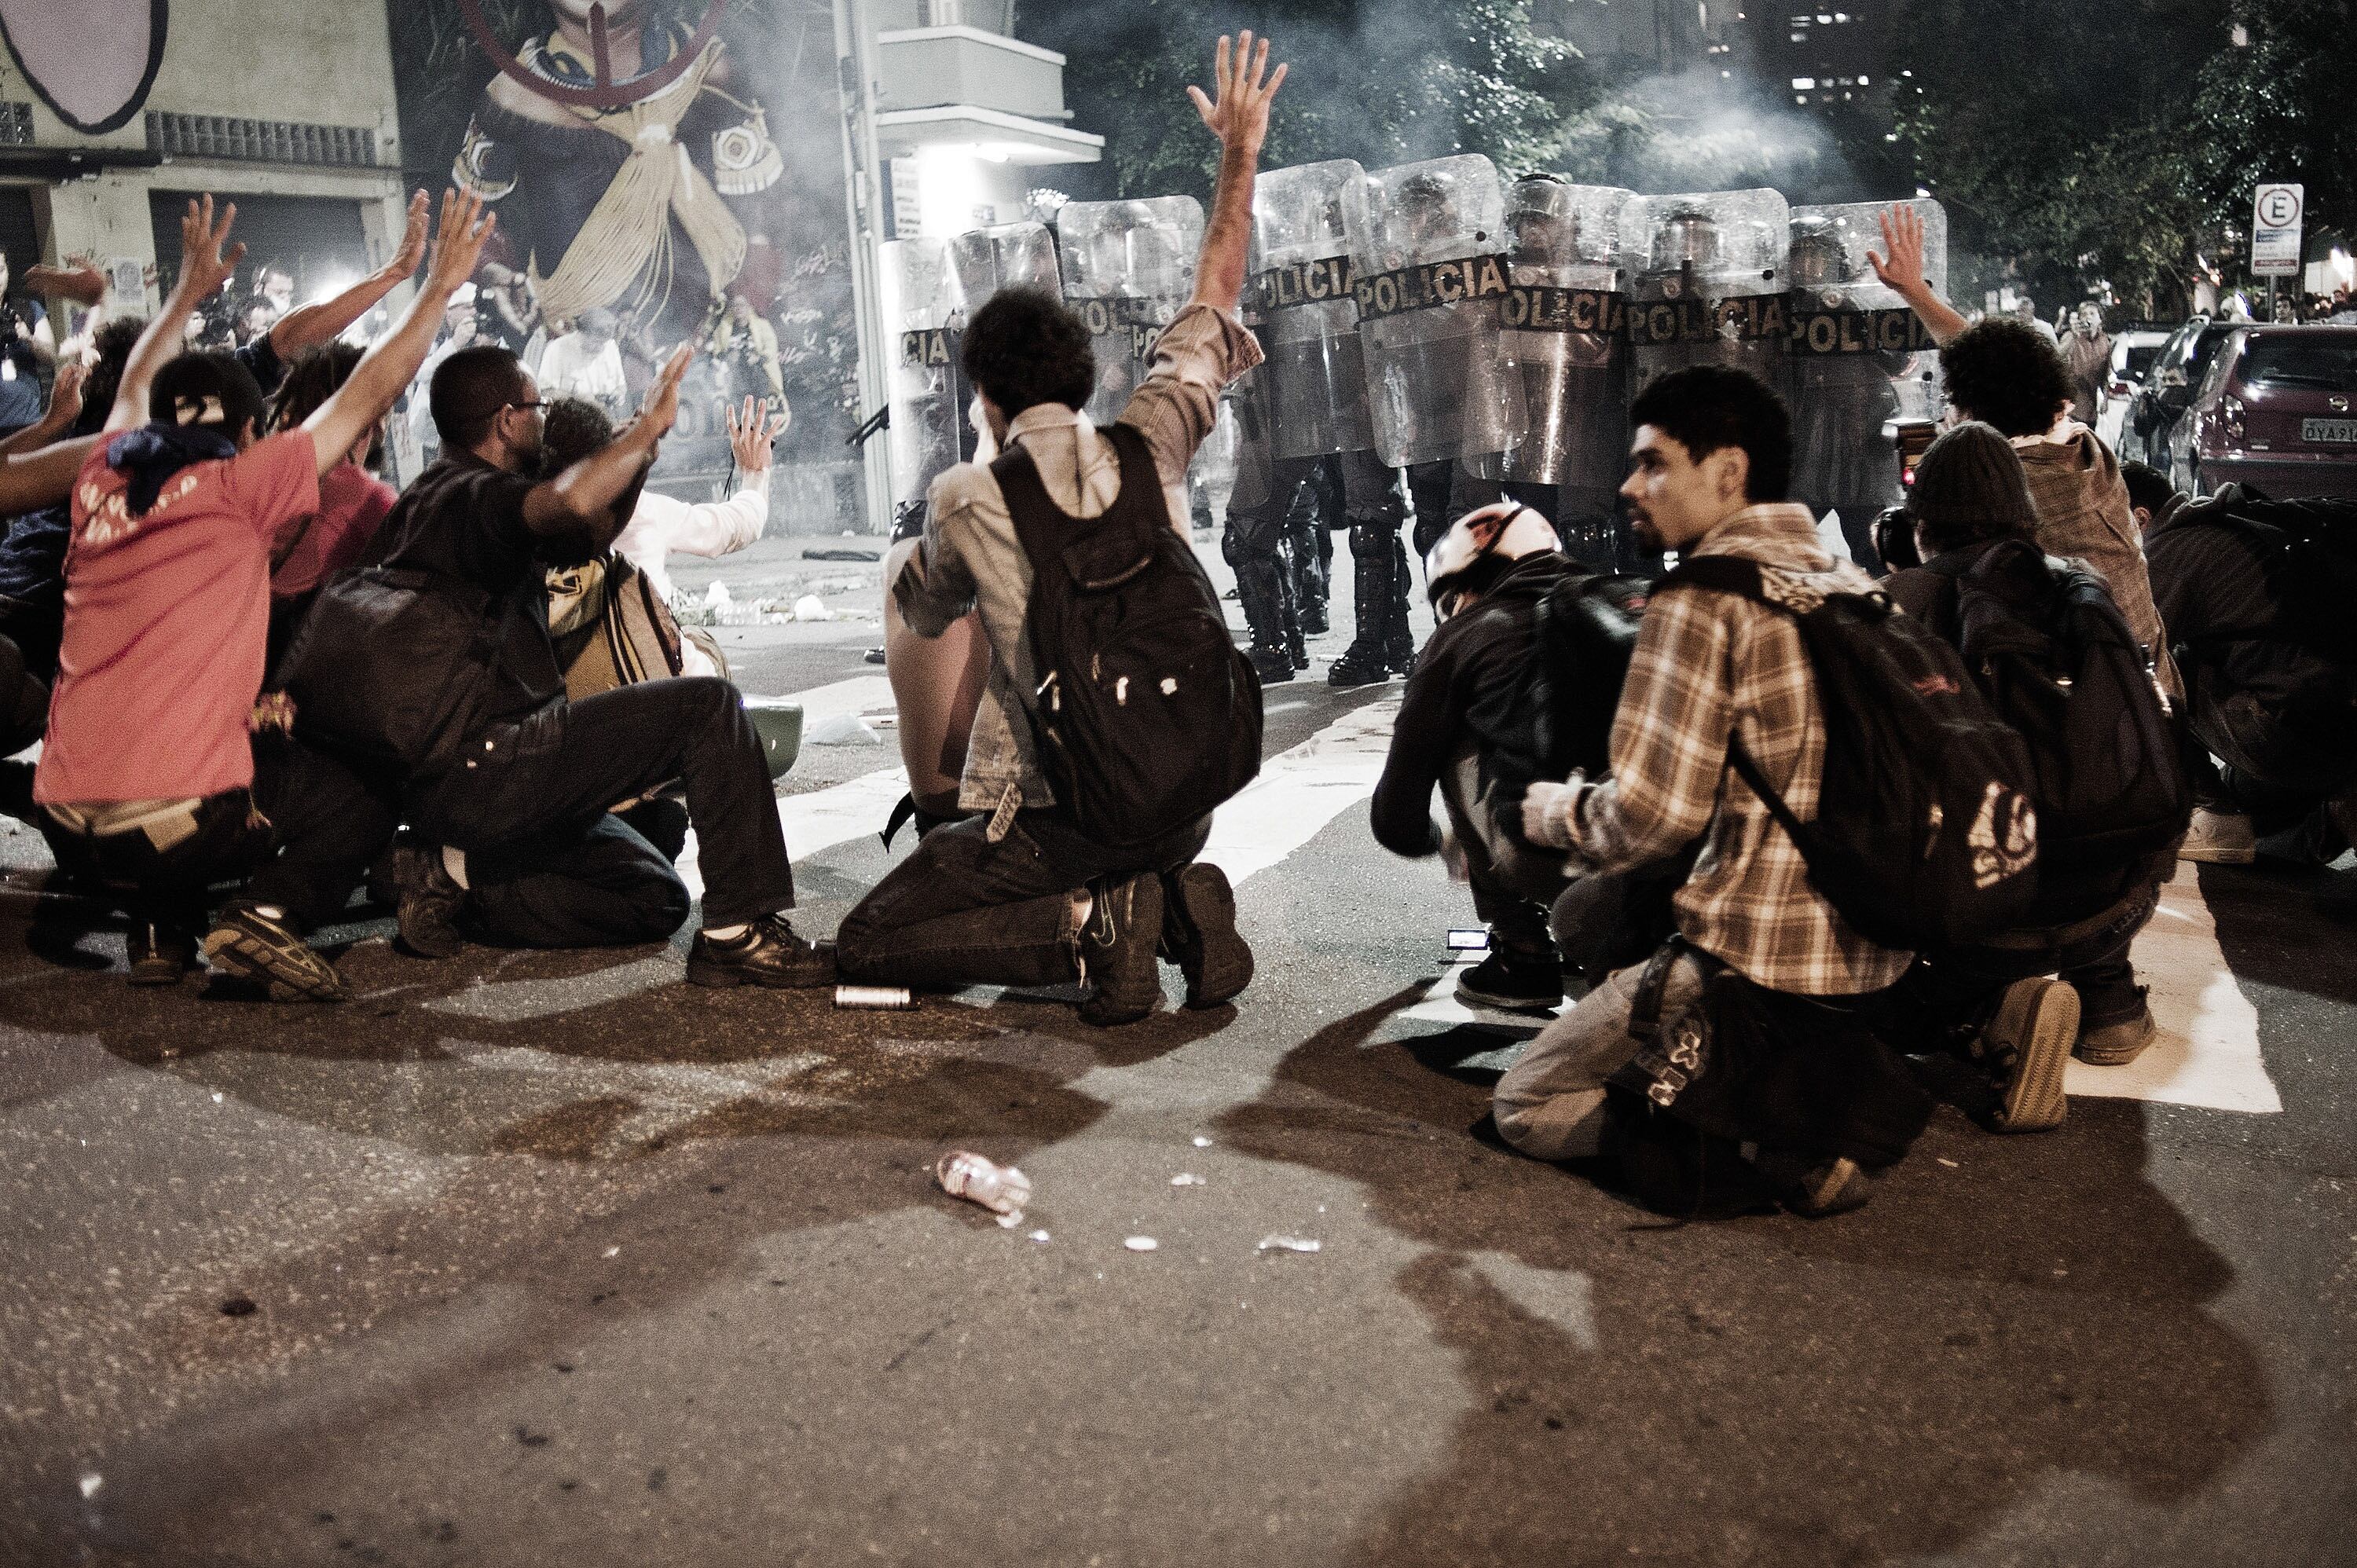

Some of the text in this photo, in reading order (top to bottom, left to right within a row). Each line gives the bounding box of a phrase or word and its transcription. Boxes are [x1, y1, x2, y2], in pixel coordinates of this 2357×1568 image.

[2272, 197, 2287, 218] E
[1355, 258, 1507, 317] POLICIA
[1627, 297, 1788, 342] POLICIA
